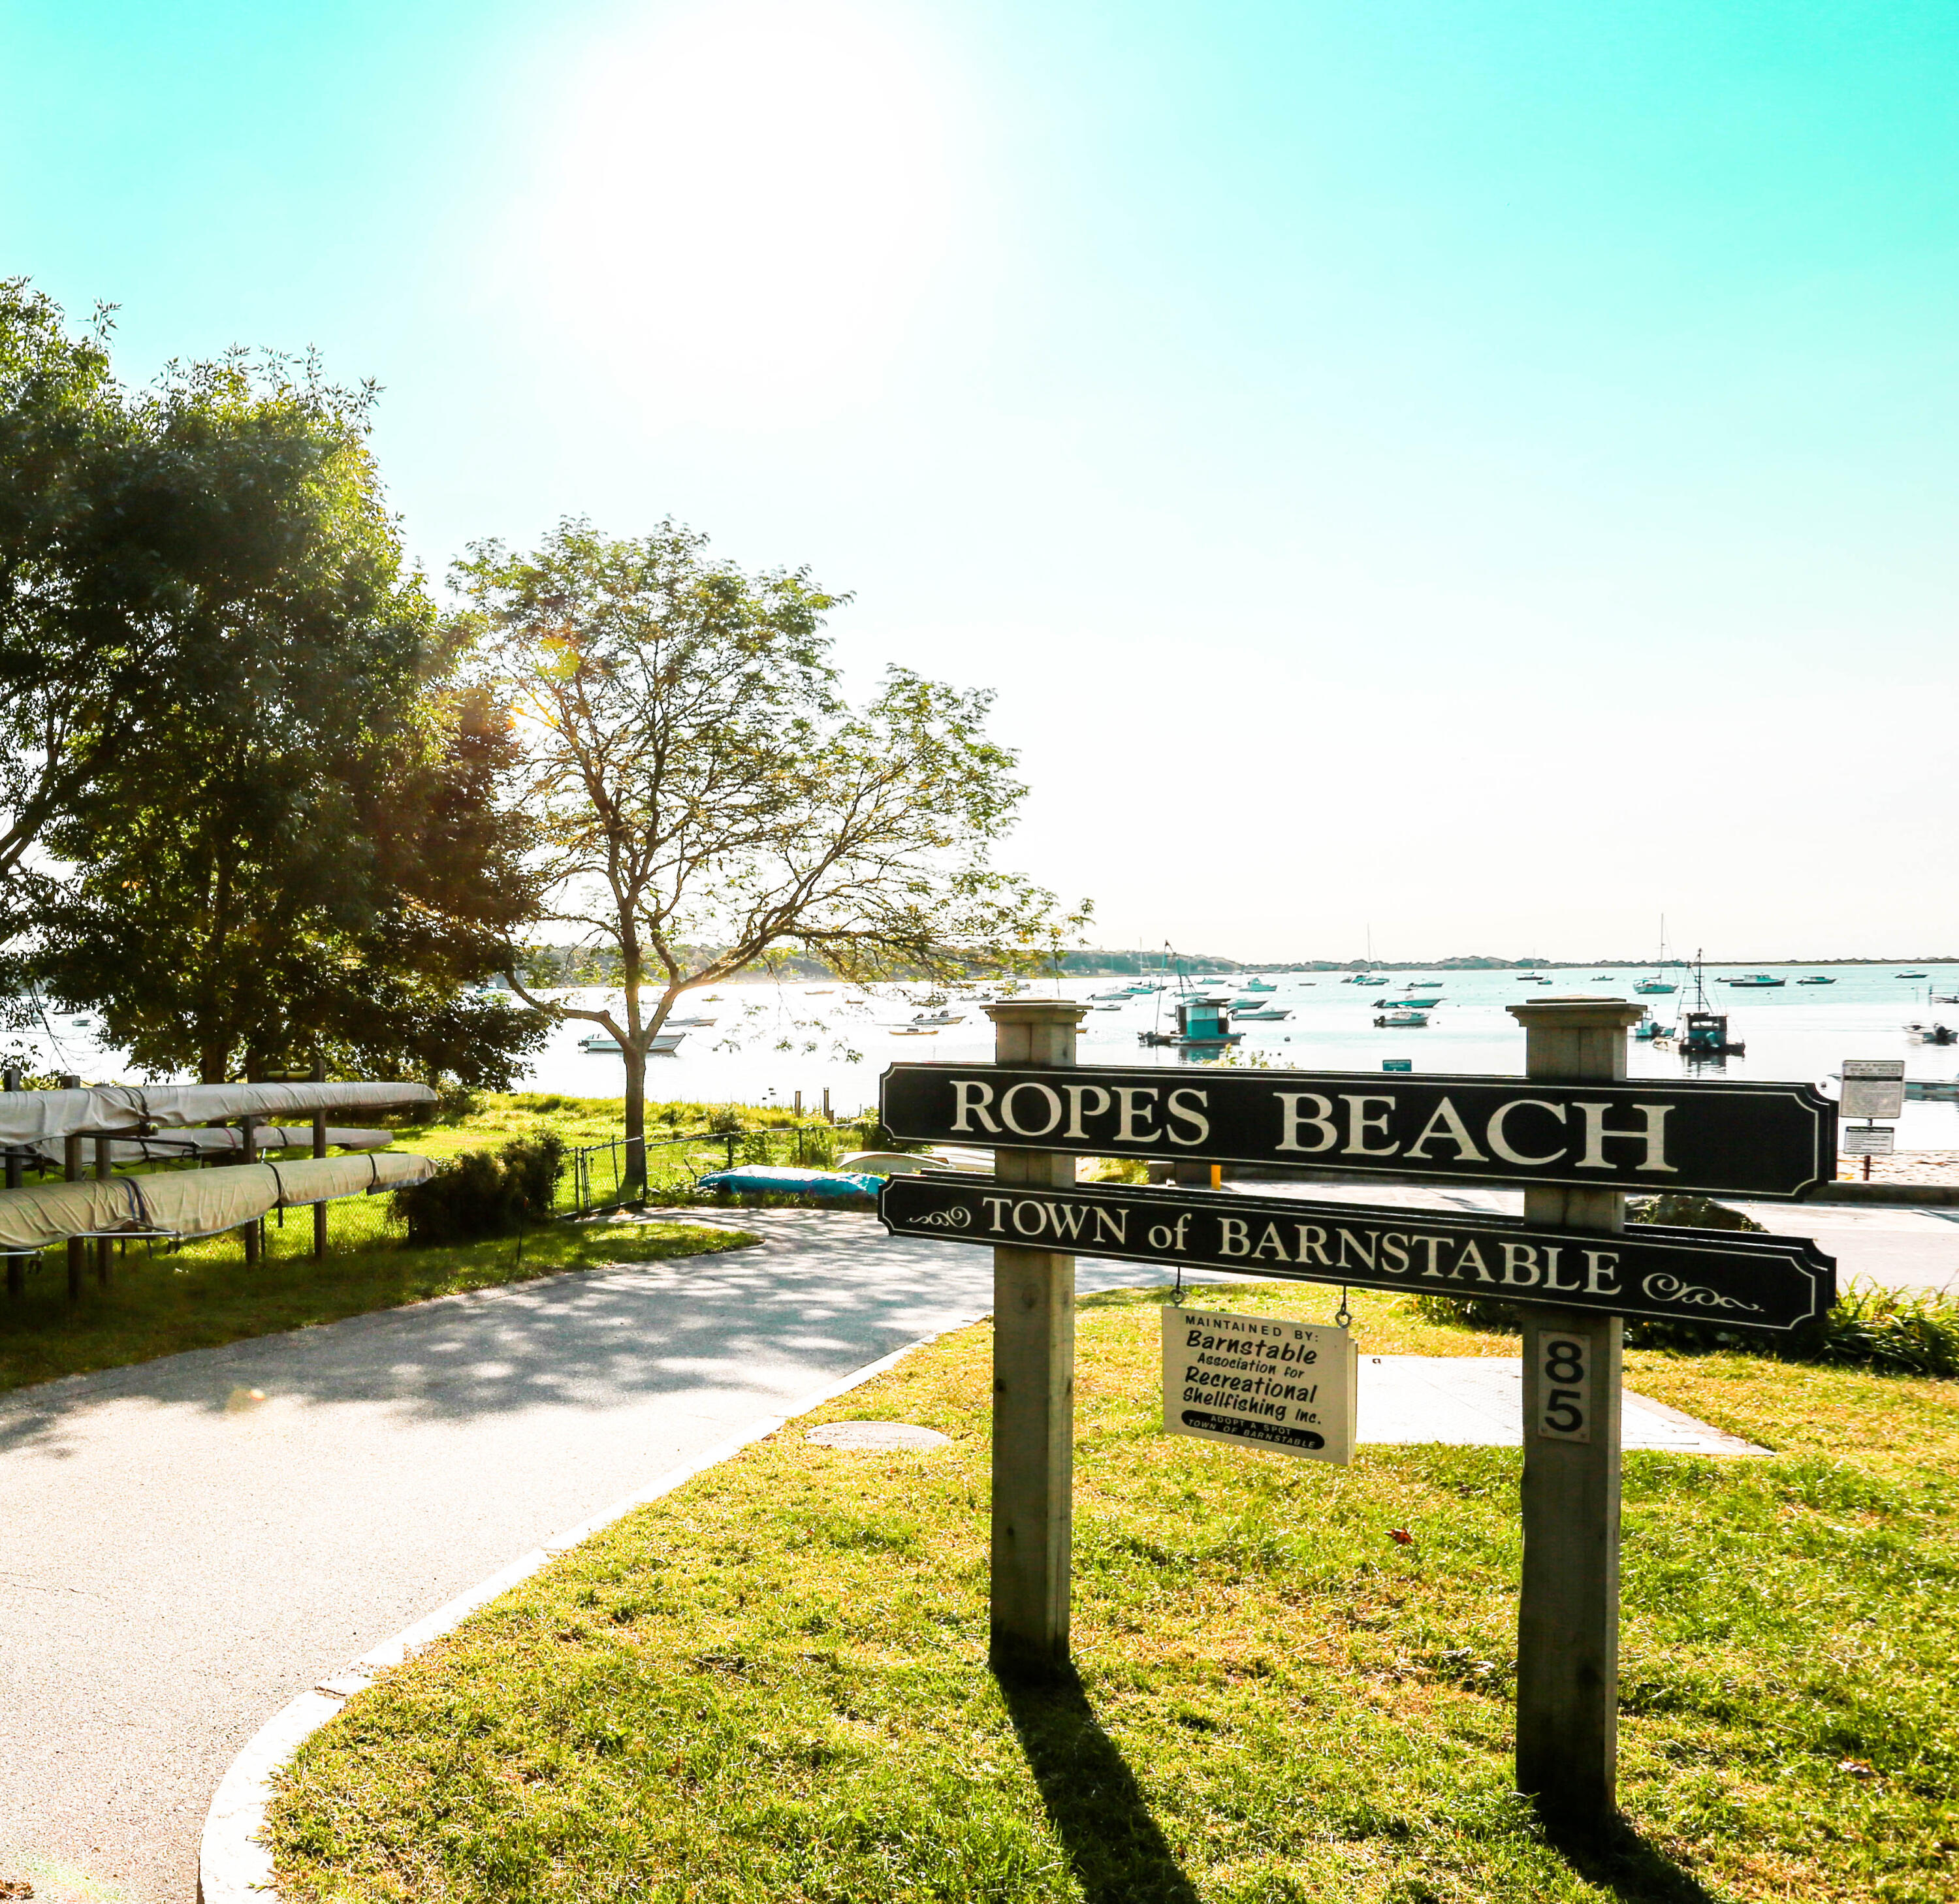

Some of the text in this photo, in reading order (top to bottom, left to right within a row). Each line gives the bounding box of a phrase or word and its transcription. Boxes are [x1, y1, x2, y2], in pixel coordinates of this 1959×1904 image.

[949, 1080, 1679, 1173] ROPES BEACH
[981, 1196, 1623, 1296] TOWN of BARNSTABLE
[1185, 1315, 1319, 1342] MAINTAINED BY:
[1186, 1329, 1318, 1365] Barnstable
[1196, 1352, 1305, 1379] Association for
[1184, 1365, 1318, 1404] Recreational
[1544, 1340, 1584, 1433] 85
[1183, 1387, 1322, 1425] Shellfishing Inc.
[1188, 1419, 1317, 1448] TOWN OF BARNSTABLE
[1211, 1414, 1245, 1427] ADOPT
[1264, 1424, 1292, 1436] SPOT
